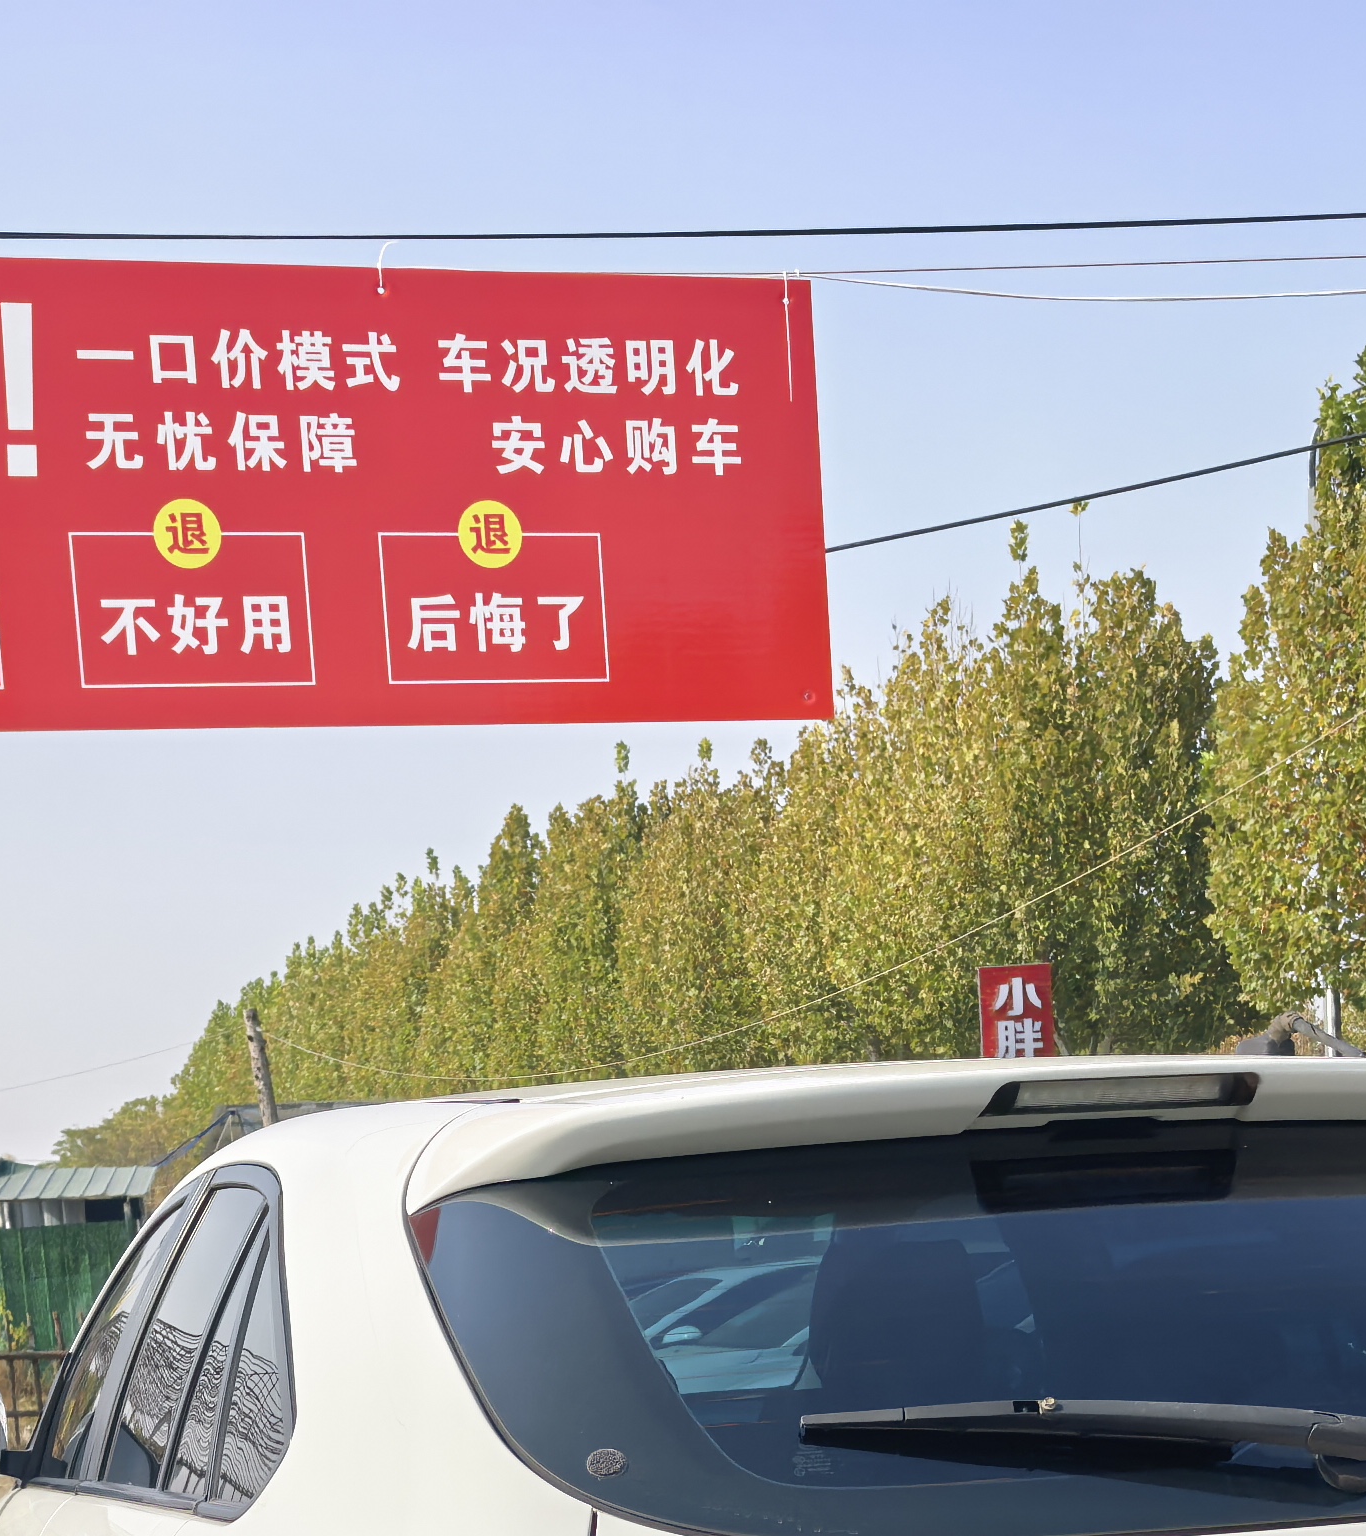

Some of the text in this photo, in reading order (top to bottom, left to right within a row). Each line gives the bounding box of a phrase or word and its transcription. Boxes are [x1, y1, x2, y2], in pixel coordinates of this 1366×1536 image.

[76, 328, 740, 397] 一口价模式 车况透明化
[86, 412, 743, 476] 无忧保障 安心购车
[165, 513, 211, 556] 退
[470, 513, 513, 556] 退
[100, 594, 293, 656] 不好用
[407, 593, 586, 652] 后悔了
